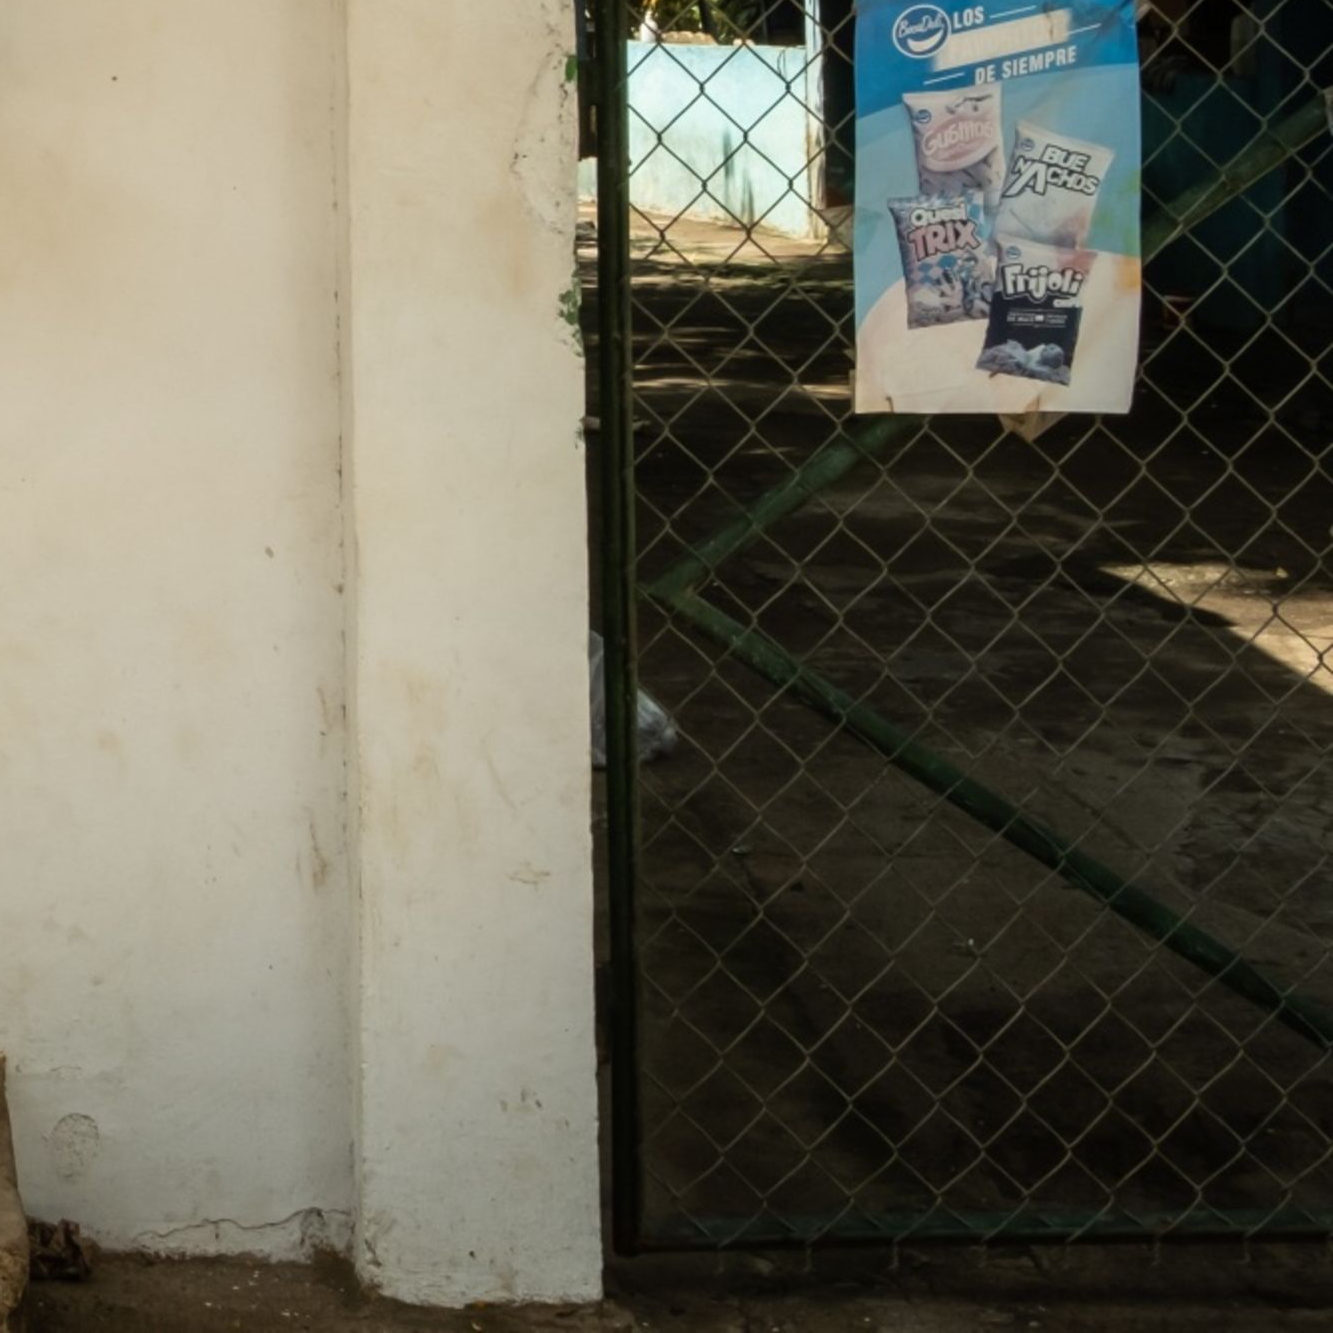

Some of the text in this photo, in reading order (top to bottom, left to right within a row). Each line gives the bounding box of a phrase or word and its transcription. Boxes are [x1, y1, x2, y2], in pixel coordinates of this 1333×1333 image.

[953, 5, 985, 29] LOS
[975, 45, 1077, 85] DE SIEMPRE
[1041, 144, 1091, 173] BUE
[907, 221, 981, 261] TRIX
[1003, 265, 1082, 299] Frijoli
